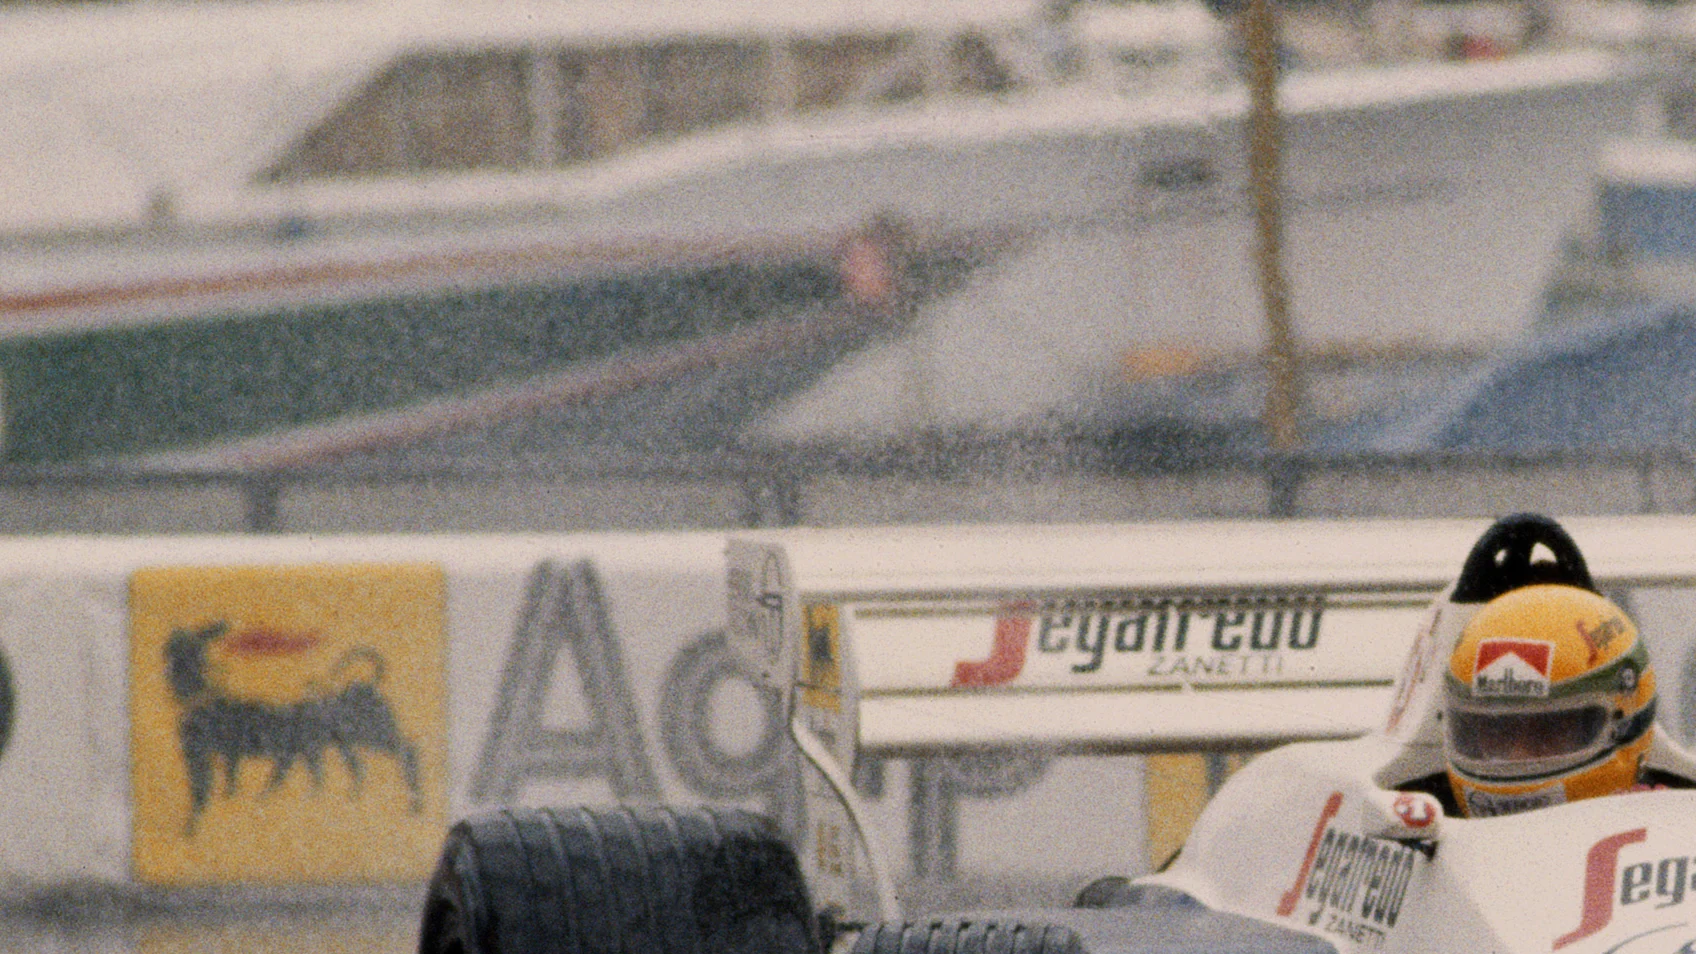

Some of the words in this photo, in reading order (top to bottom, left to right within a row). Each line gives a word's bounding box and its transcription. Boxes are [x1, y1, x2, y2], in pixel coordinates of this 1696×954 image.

[1147, 654, 1286, 677] ZANETTI
[1476, 667, 1545, 694] Marlboro
[1276, 790, 1416, 928] Segafredo
